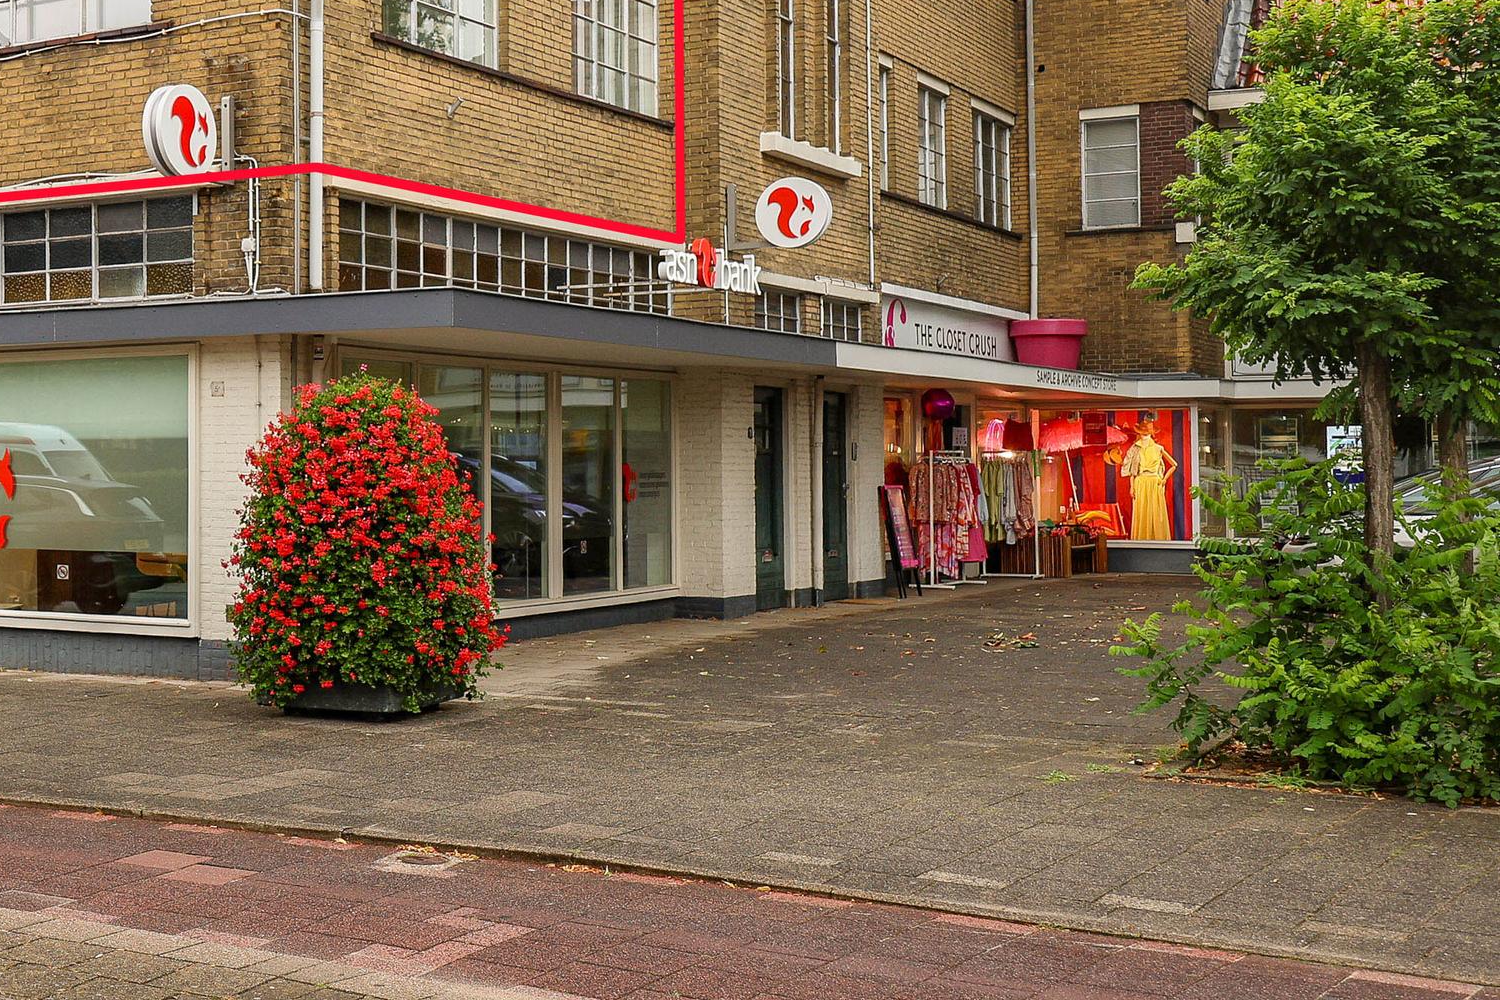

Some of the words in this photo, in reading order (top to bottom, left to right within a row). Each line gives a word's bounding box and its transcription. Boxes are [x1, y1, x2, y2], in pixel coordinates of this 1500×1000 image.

[658, 249, 698, 285] asn
[714, 248, 762, 295] bank
[914, 323, 933, 347] THE
[936, 327, 967, 352] CLOSET
[969, 333, 997, 358] CRUSH
[1036, 370, 1056, 385] SAMPLE
[1061, 373, 1082, 388] ARCHIVE
[1082, 375, 1103, 389] CONCEPT
[1103, 378, 1117, 391] STORE
